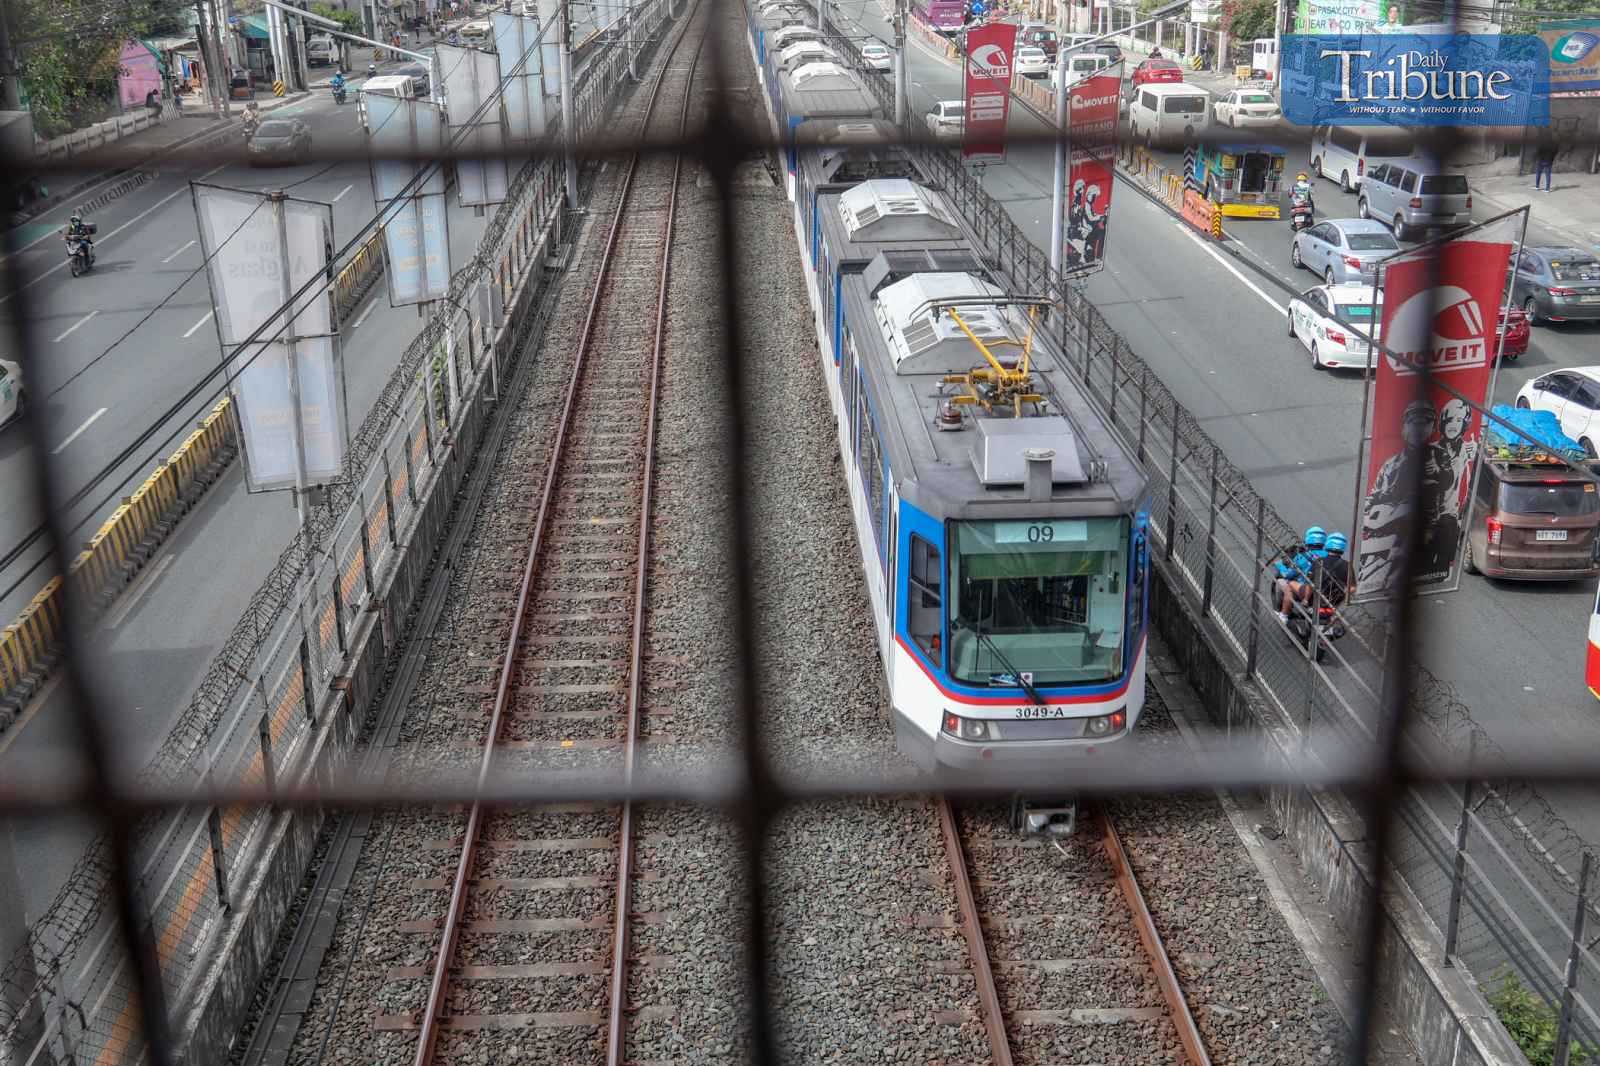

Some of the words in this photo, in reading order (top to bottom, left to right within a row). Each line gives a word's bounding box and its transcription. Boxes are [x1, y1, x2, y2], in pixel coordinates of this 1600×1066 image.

[1342, 6, 1359, 15] CITY
[1027, 525, 1054, 543] 09
[1015, 707, 1064, 719] 3049-A
